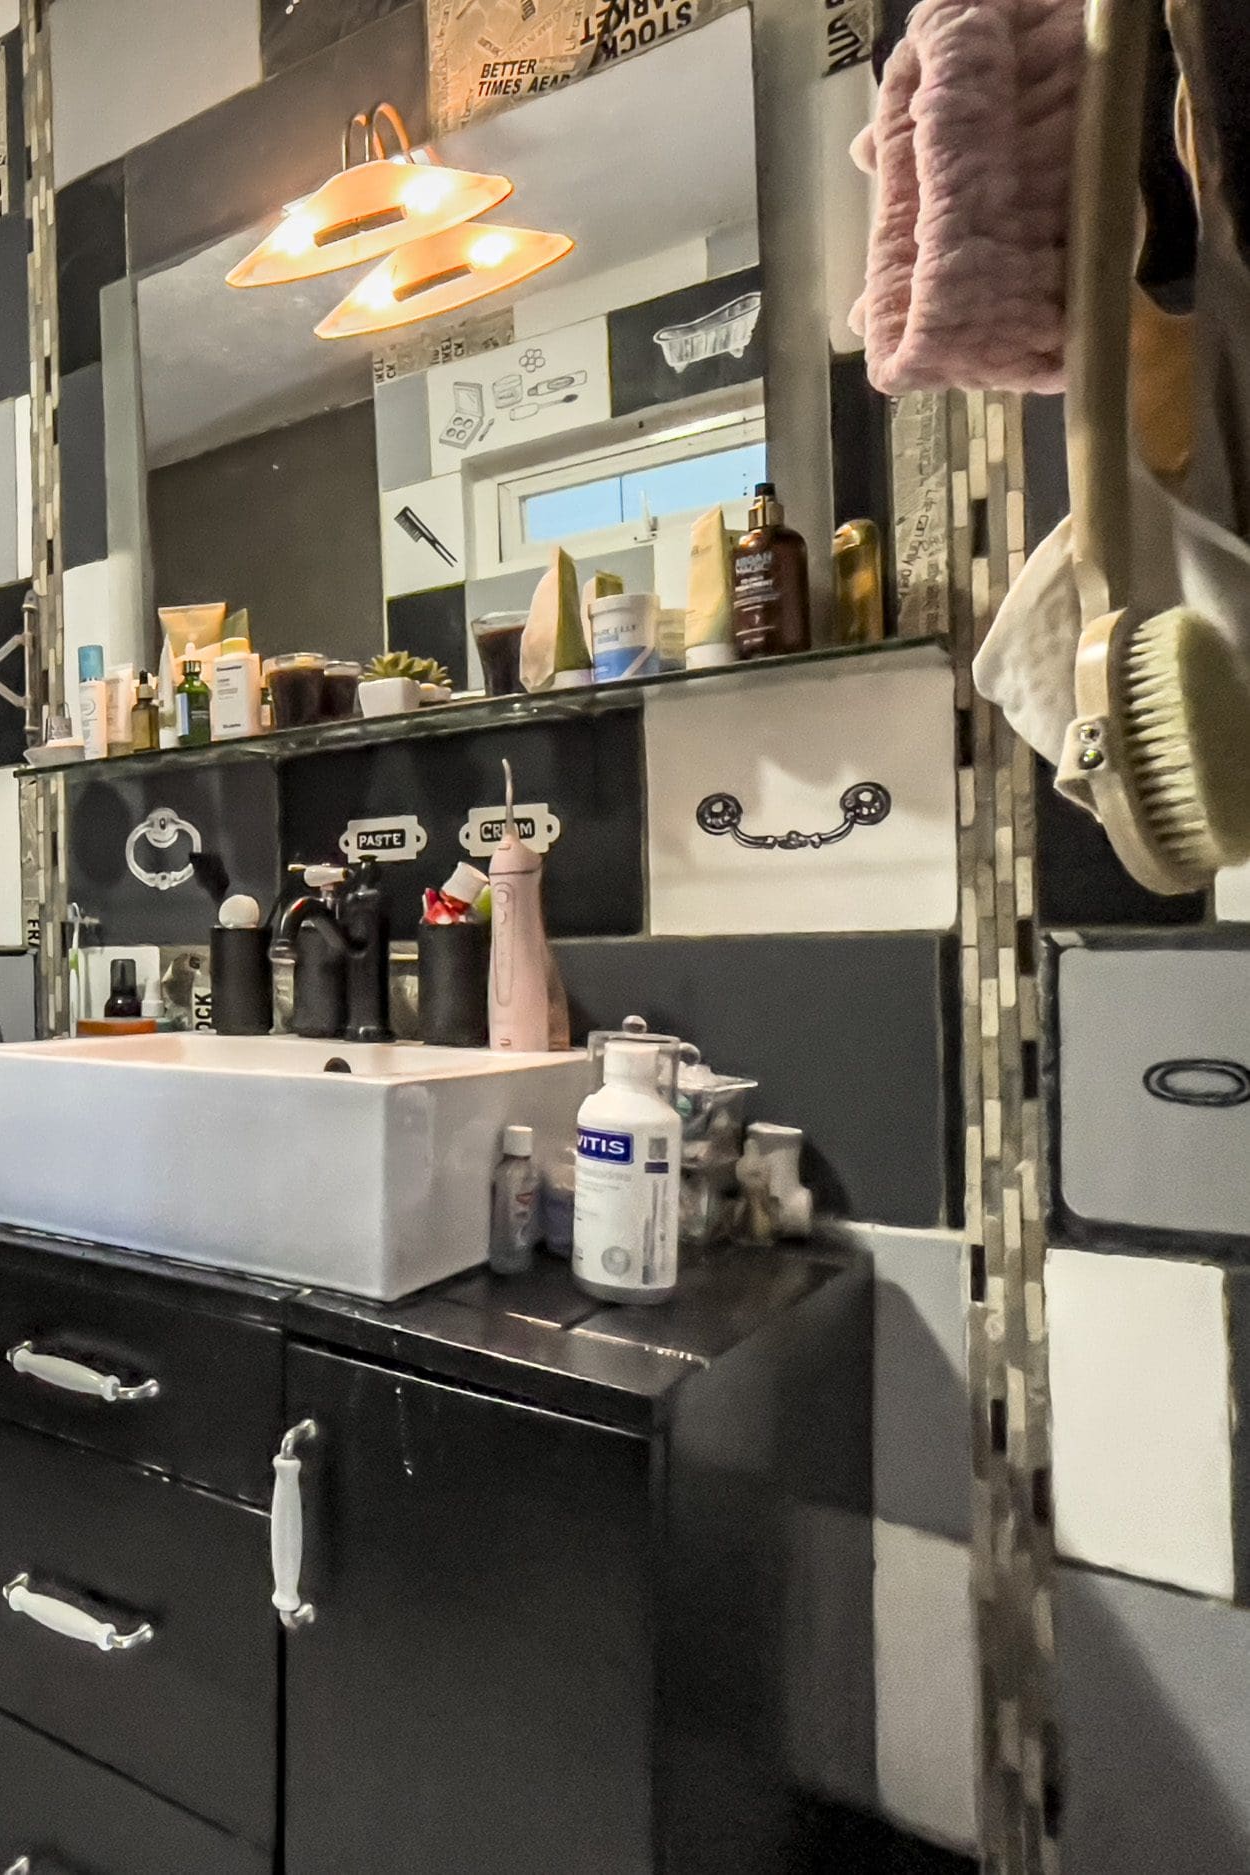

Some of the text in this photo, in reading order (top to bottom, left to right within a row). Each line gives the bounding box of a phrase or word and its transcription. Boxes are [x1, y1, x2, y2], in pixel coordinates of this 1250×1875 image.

[601, 1, 692, 62] STOCK
[480, 58, 537, 79] BETTER
[477, 77, 522, 97] TIMES
[359, 833, 402, 848] PASTE
[481, 822, 533, 839] CRM
